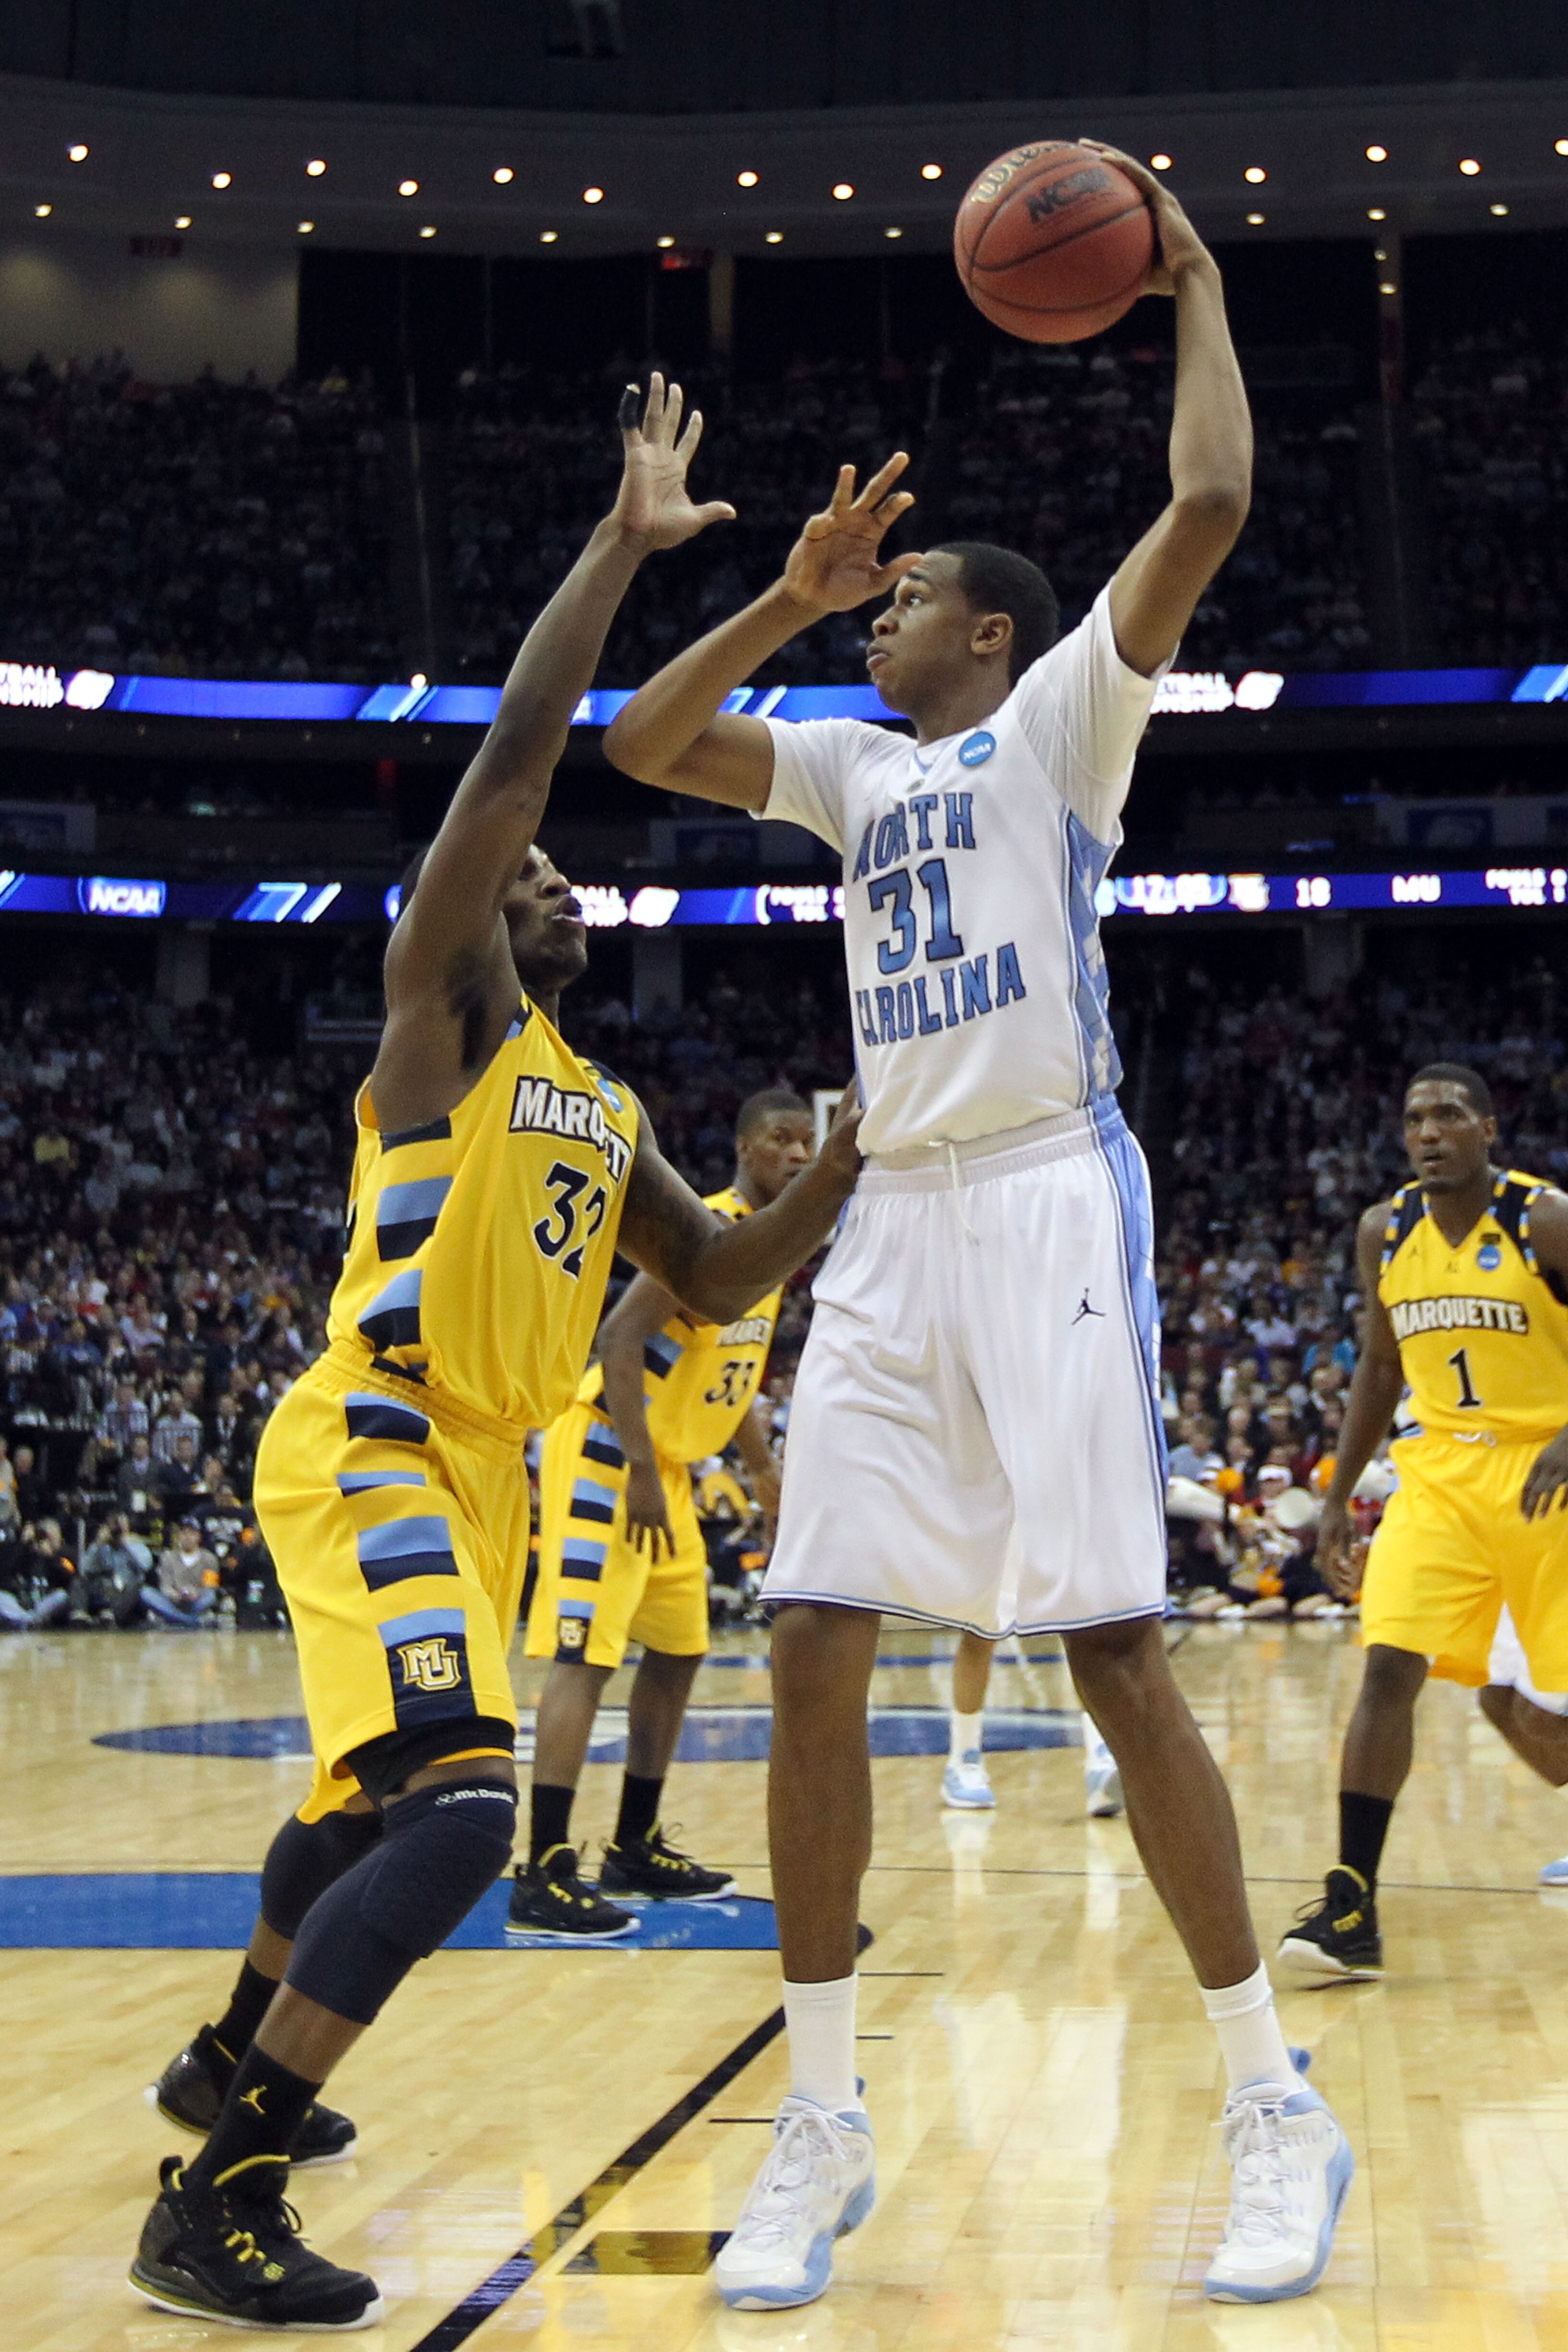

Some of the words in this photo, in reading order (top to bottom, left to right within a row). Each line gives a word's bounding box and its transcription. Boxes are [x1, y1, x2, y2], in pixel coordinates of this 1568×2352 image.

[852, 793, 977, 884] NORTH
[88, 886, 160, 914] NCAA
[867, 858, 965, 976] 31
[1392, 874, 1442, 903] MU
[532, 1159, 607, 1283] 32
[1391, 1296, 1529, 1342] MARQUETTE
[1448, 1346, 1484, 1410] 1
[396, 1637, 462, 1691] MU
